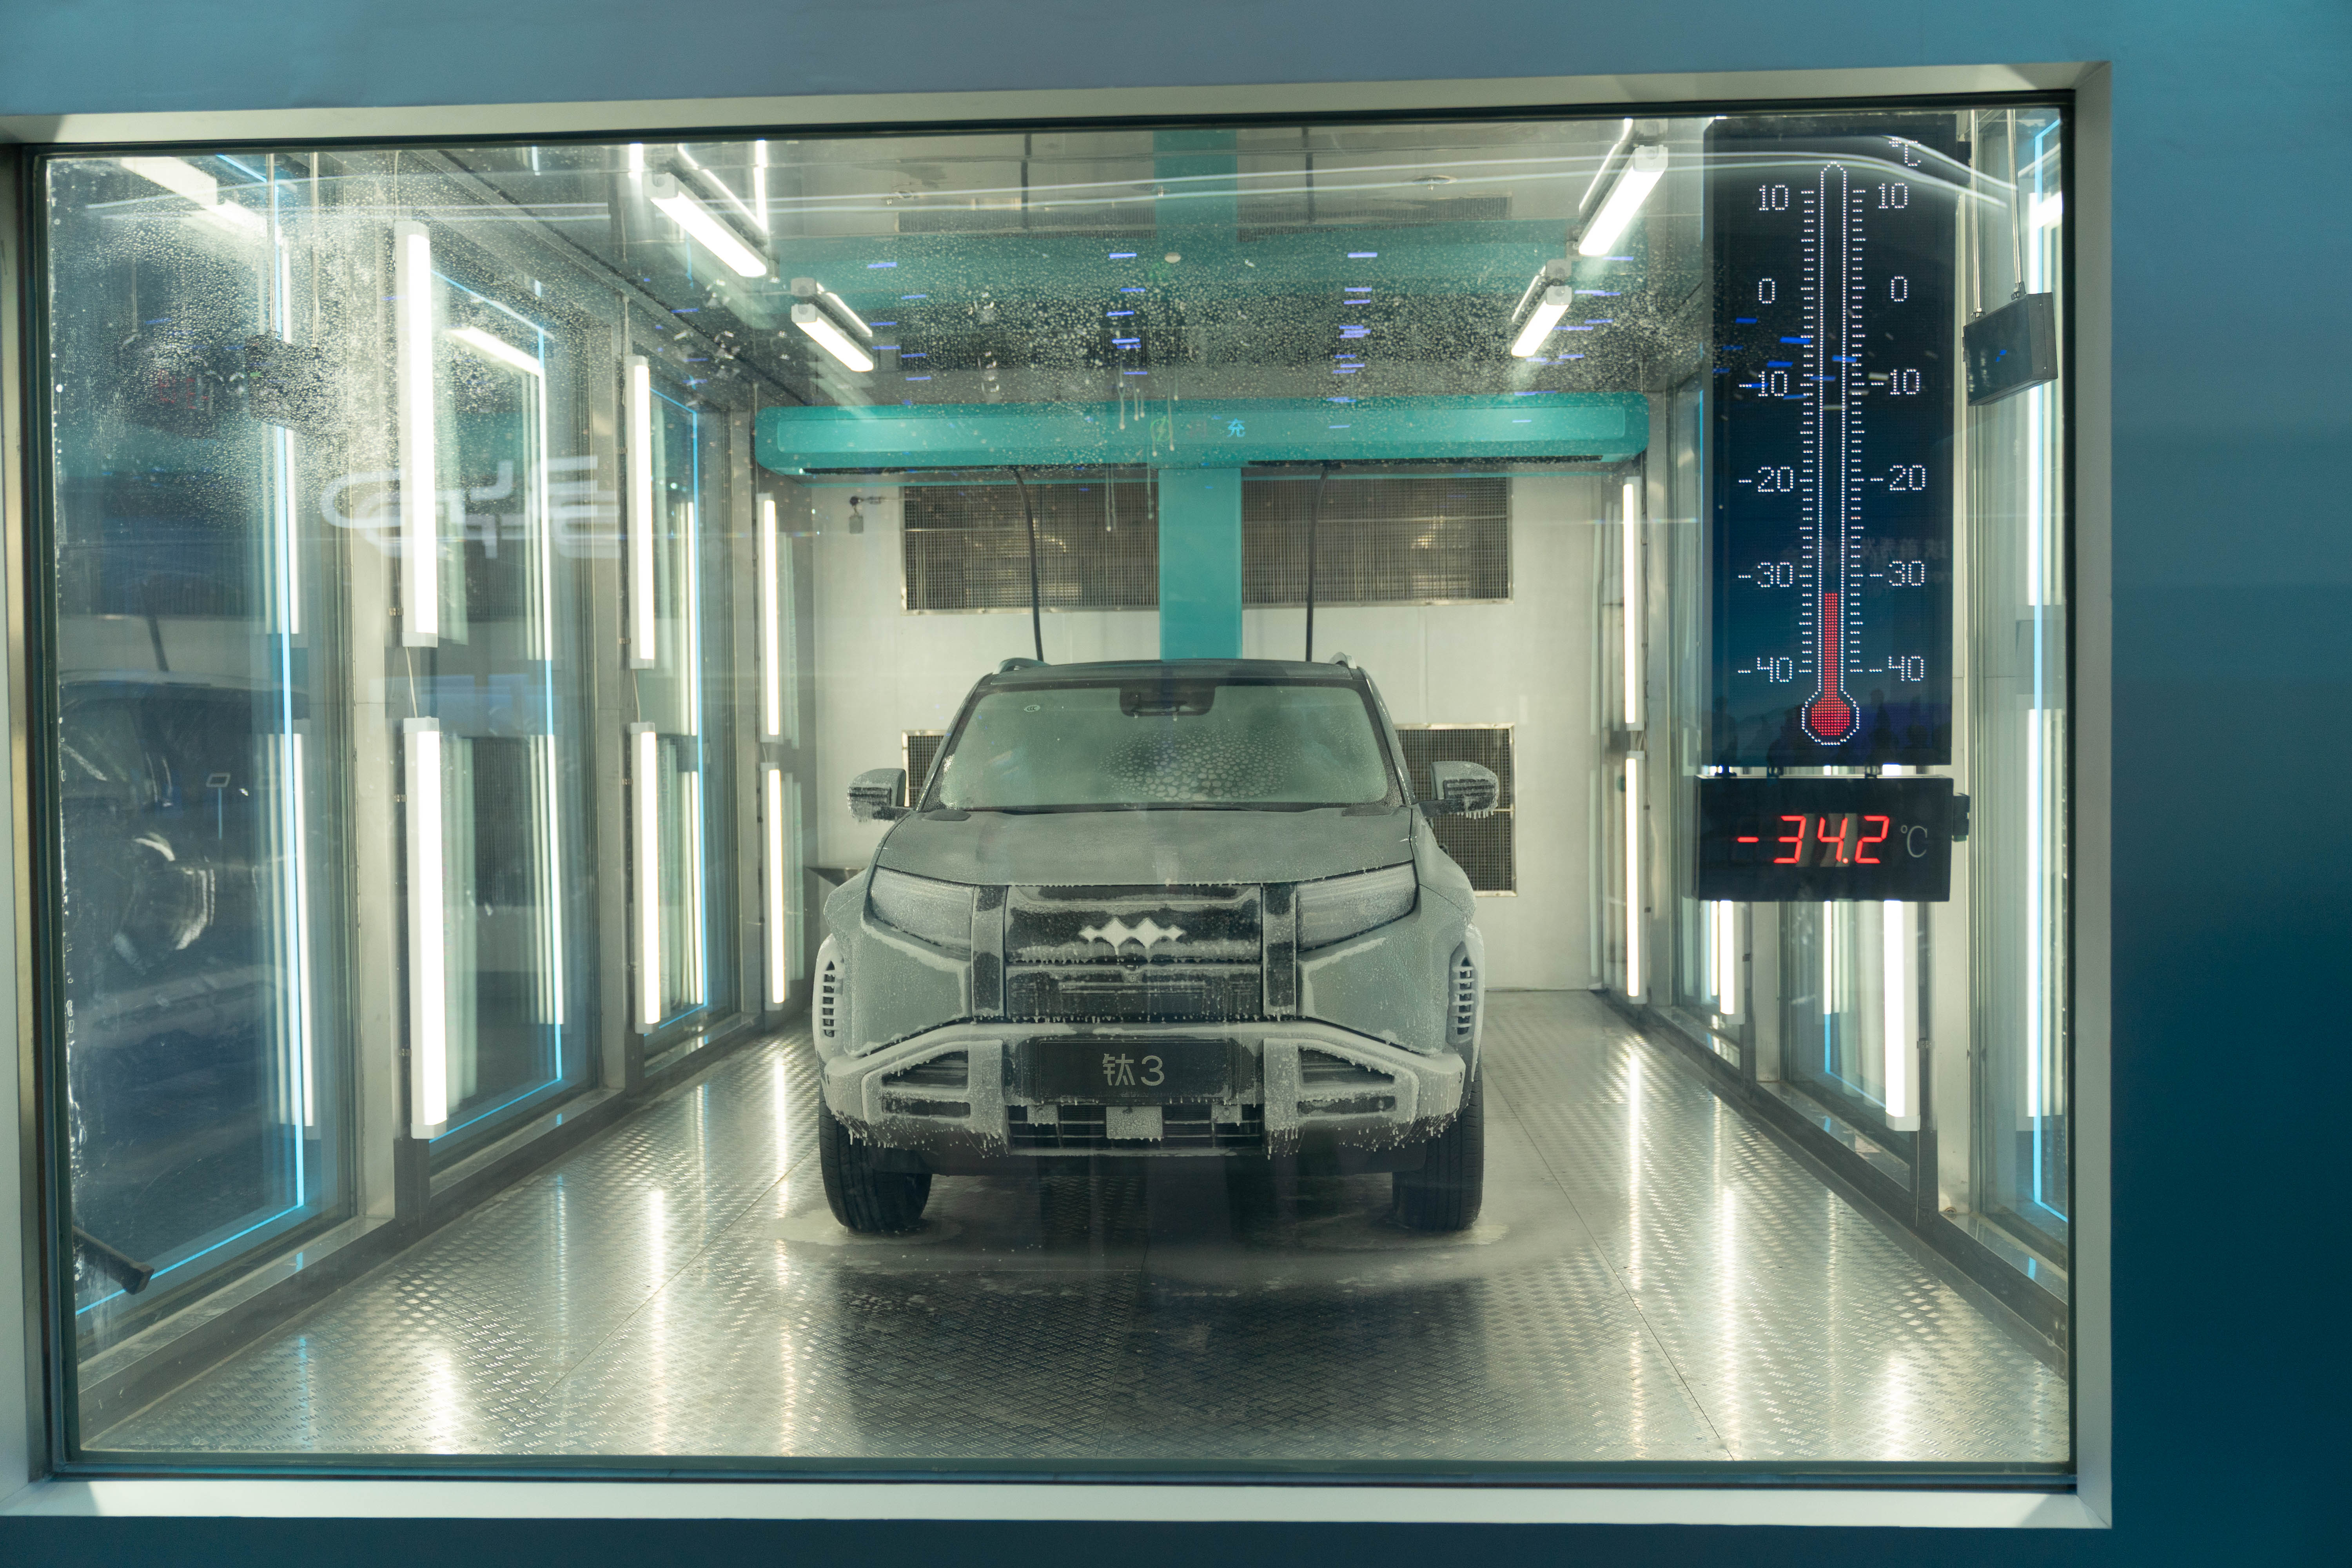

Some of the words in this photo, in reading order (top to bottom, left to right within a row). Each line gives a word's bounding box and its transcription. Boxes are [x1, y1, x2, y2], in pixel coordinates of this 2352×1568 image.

[1759, 185, 1789, 211] 10
[1878, 182, 1909, 209] 10
[1758, 278, 1775, 304] 0
[1891, 276, 1908, 302] 0
[1739, 370, 1788, 397] -10
[1871, 368, 1921, 395] -10
[1738, 466, 1794, 493] -20
[1870, 465, 1926, 491] -20
[1738, 562, 1793, 588] -30
[1869, 560, 1925, 586] -30
[1737, 657, 1793, 683] -40
[1869, 655, 1924, 682] -40
[1737, 815, 1890, 864] -34.2
[1102, 1053, 1165, 1086] 钛3
